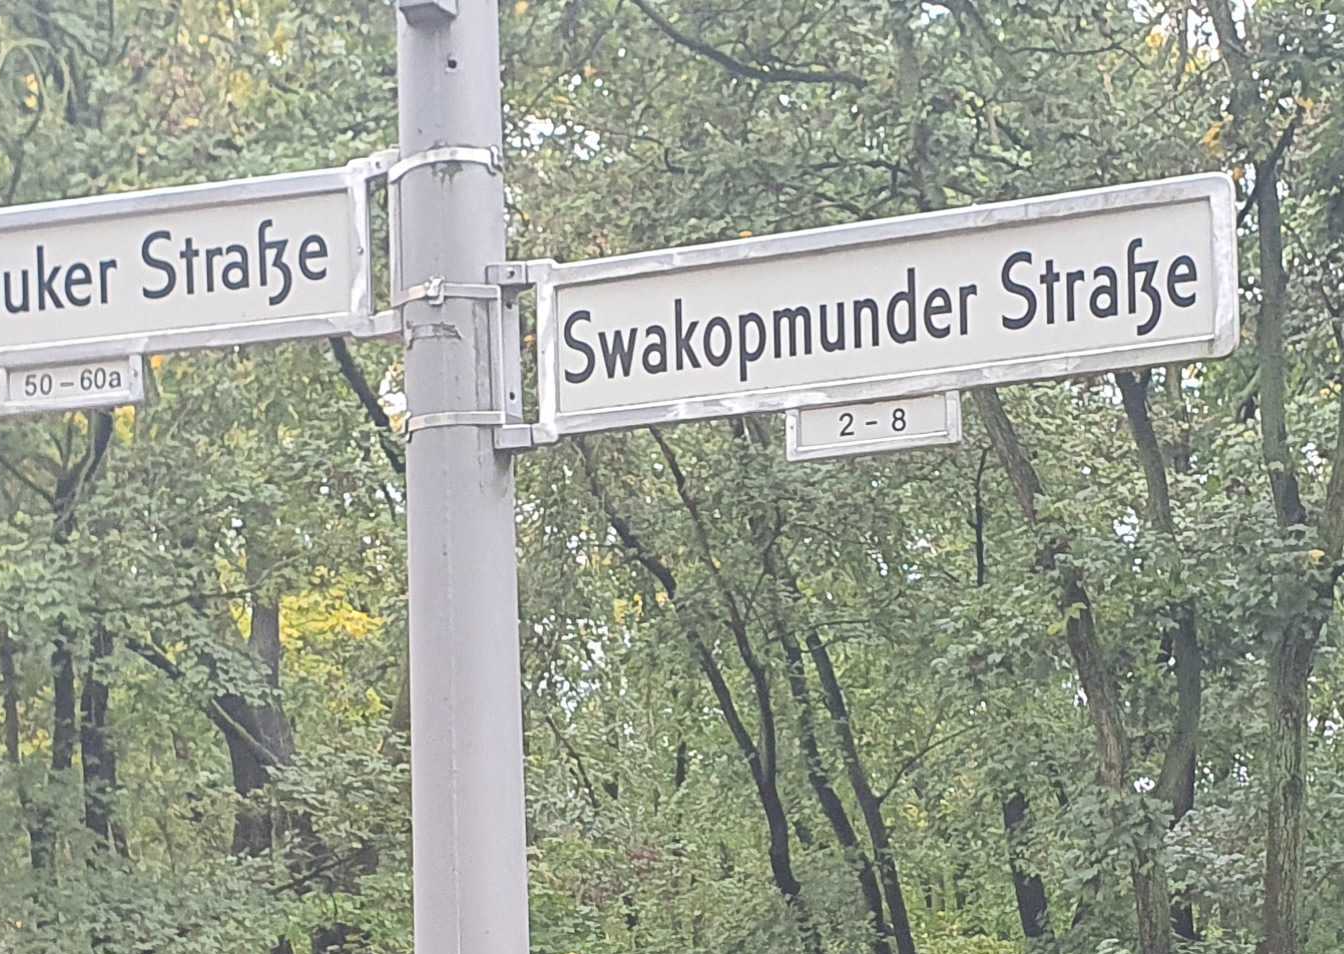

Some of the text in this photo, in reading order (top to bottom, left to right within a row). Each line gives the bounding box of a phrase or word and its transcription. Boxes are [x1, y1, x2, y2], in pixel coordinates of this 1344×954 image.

[141, 218, 329, 306] Straße
[563, 238, 1198, 385] Swakopmunder Straße
[24, 373, 52, 396] 50
[80, 367, 122, 391] 60a
[839, 412, 855, 437] 2
[891, 407, 906, 432] 8
